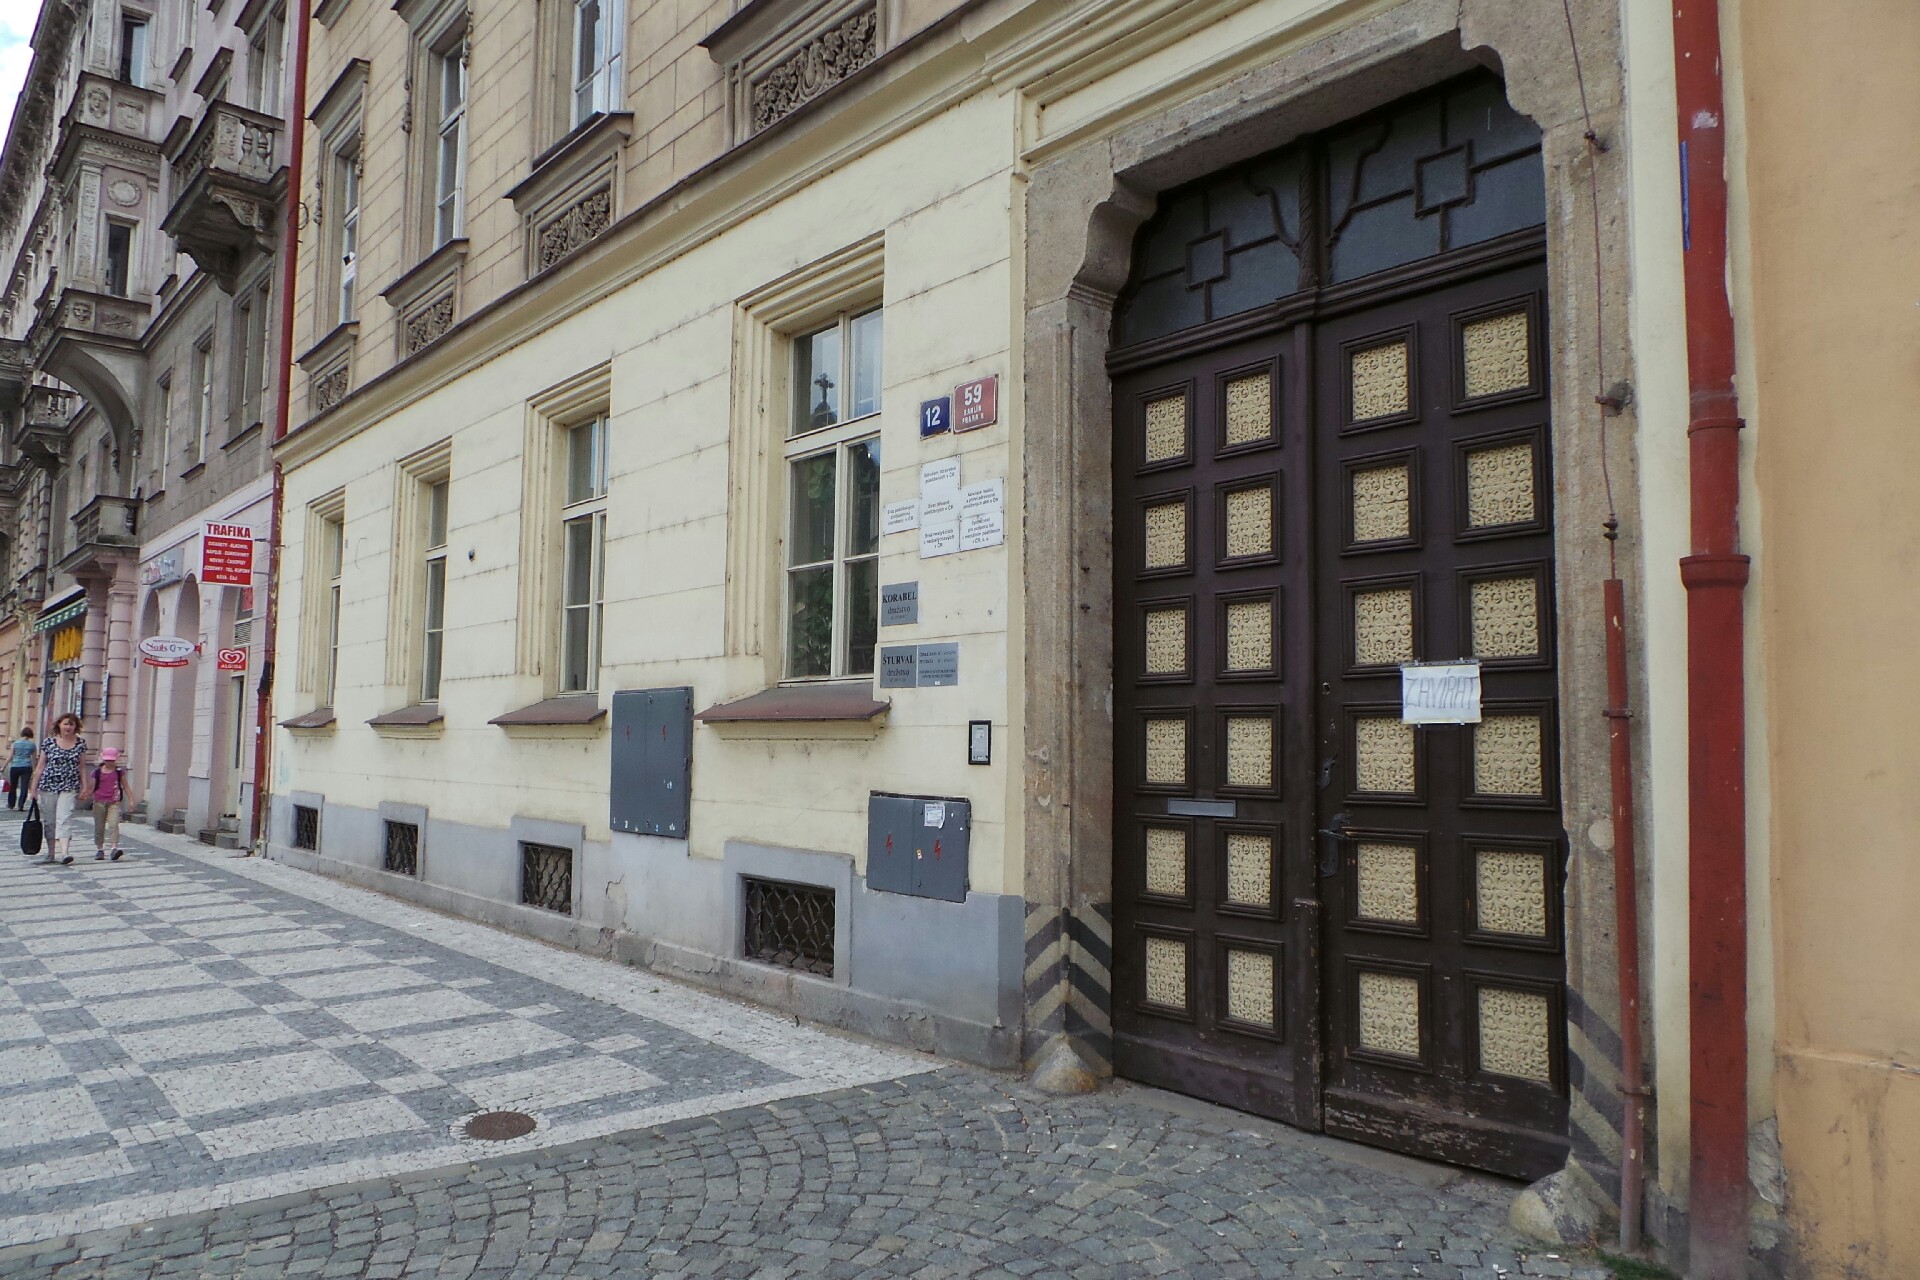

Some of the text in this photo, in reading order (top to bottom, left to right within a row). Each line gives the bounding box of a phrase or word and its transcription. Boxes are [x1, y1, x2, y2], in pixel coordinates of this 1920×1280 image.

[964, 383, 982, 406] 59
[925, 405, 941, 428] 12
[206, 523, 251, 538] TRAFIKA
[882, 592, 917, 604] KORABEL
[882, 654, 915, 665] ŠTURVAL
[1404, 667, 1479, 710] ZAVÍRAT
